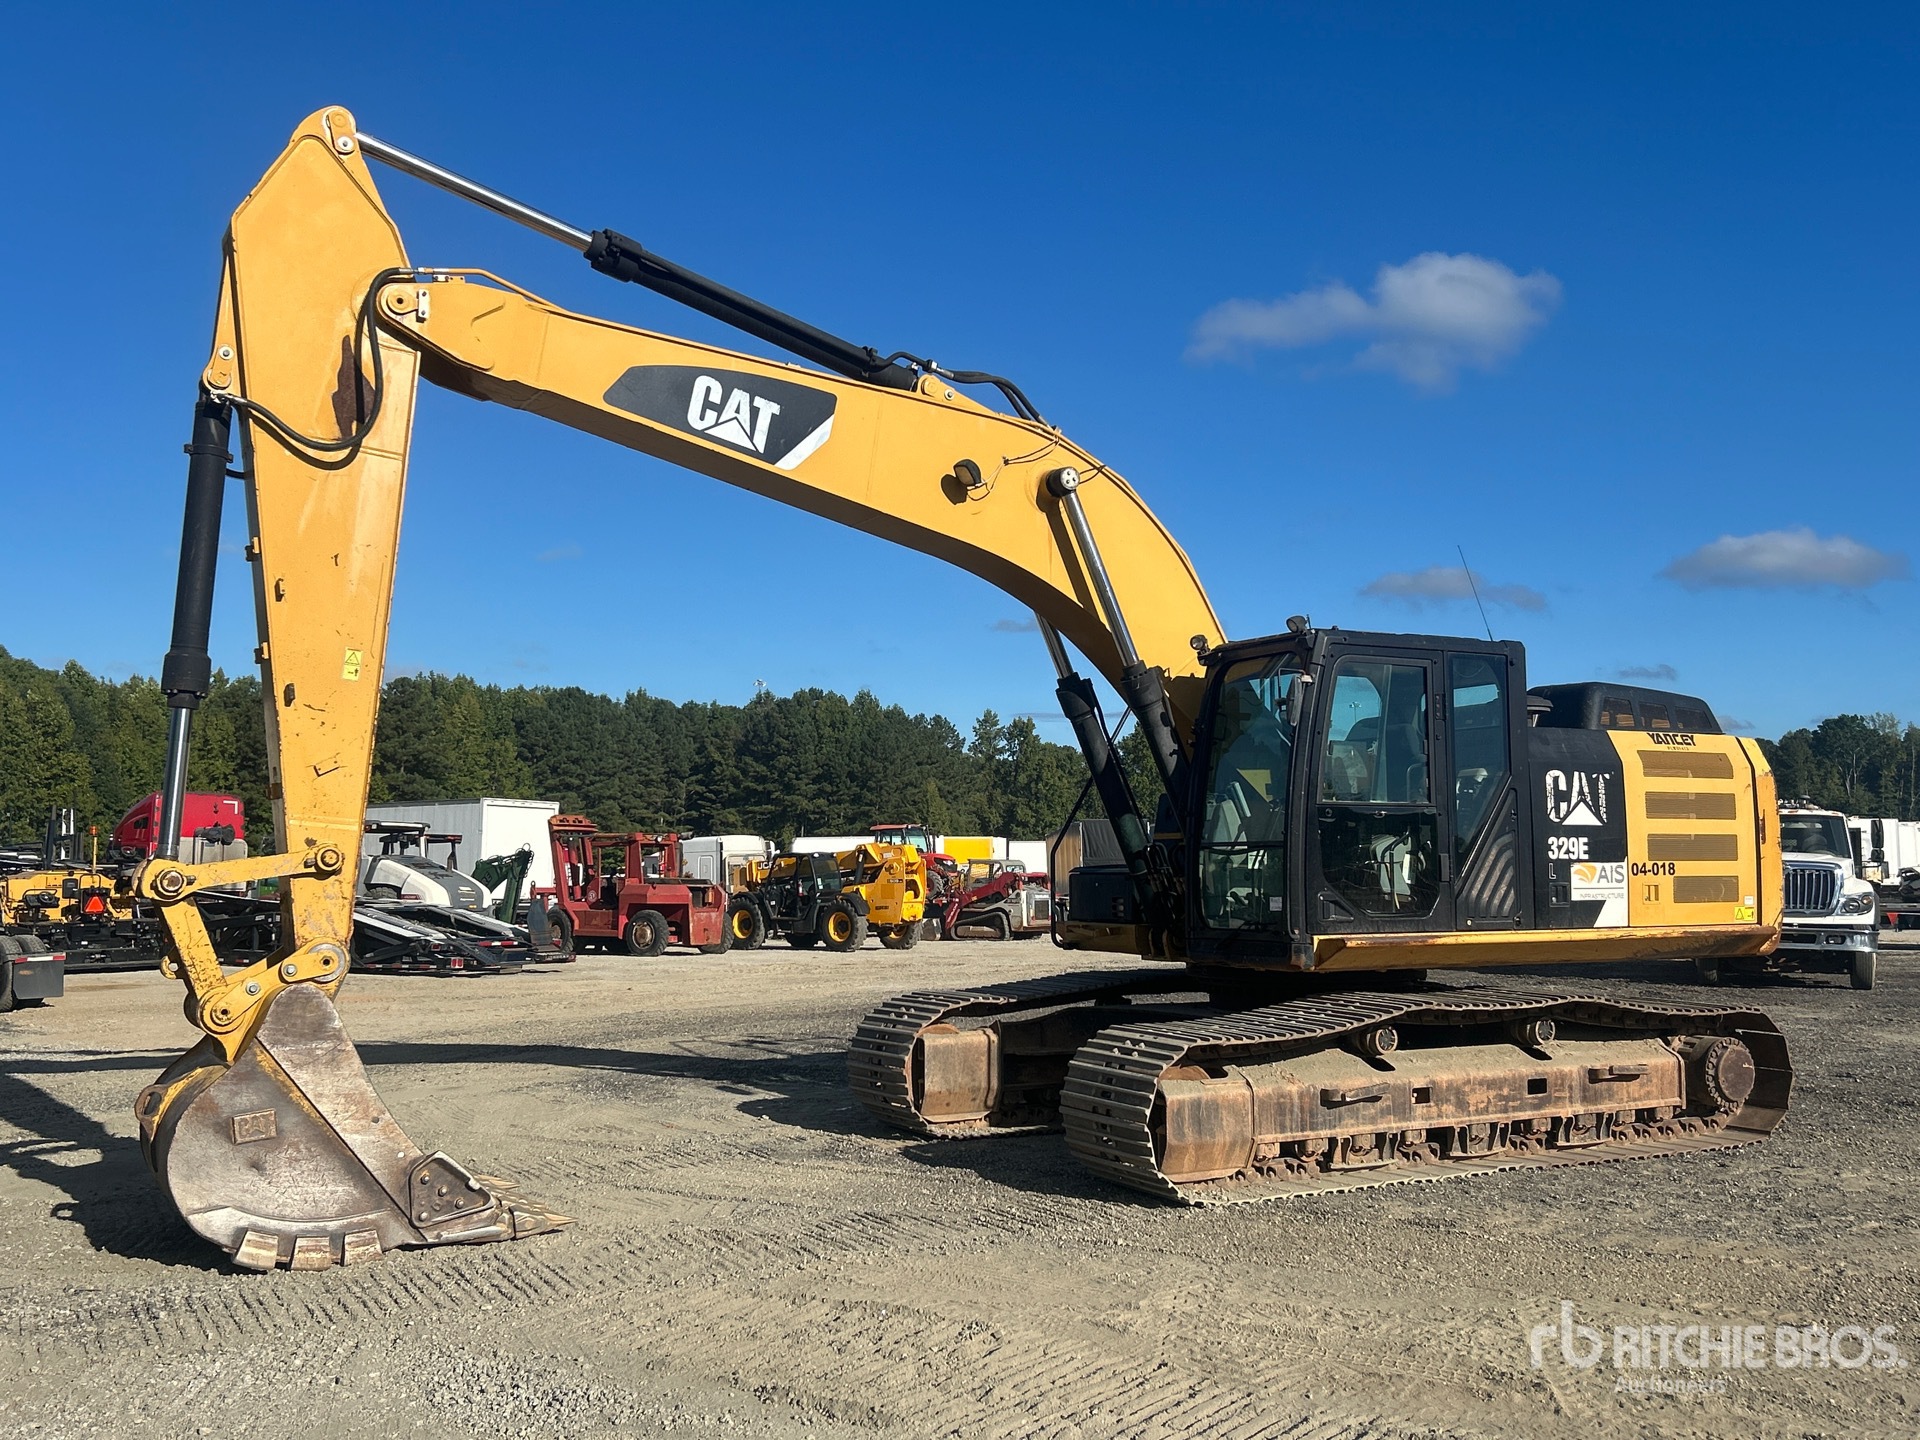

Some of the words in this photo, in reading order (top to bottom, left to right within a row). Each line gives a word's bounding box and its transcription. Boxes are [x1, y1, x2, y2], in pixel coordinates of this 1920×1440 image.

[687, 375, 781, 454] CAT
[1647, 732, 1696, 747] YANCEY
[1545, 769, 1610, 825] CAT
[1547, 836, 1589, 860] 329E
[1548, 862, 1557, 880] L
[1597, 864, 1625, 884] AIS
[1630, 862, 1676, 876] 04-018
